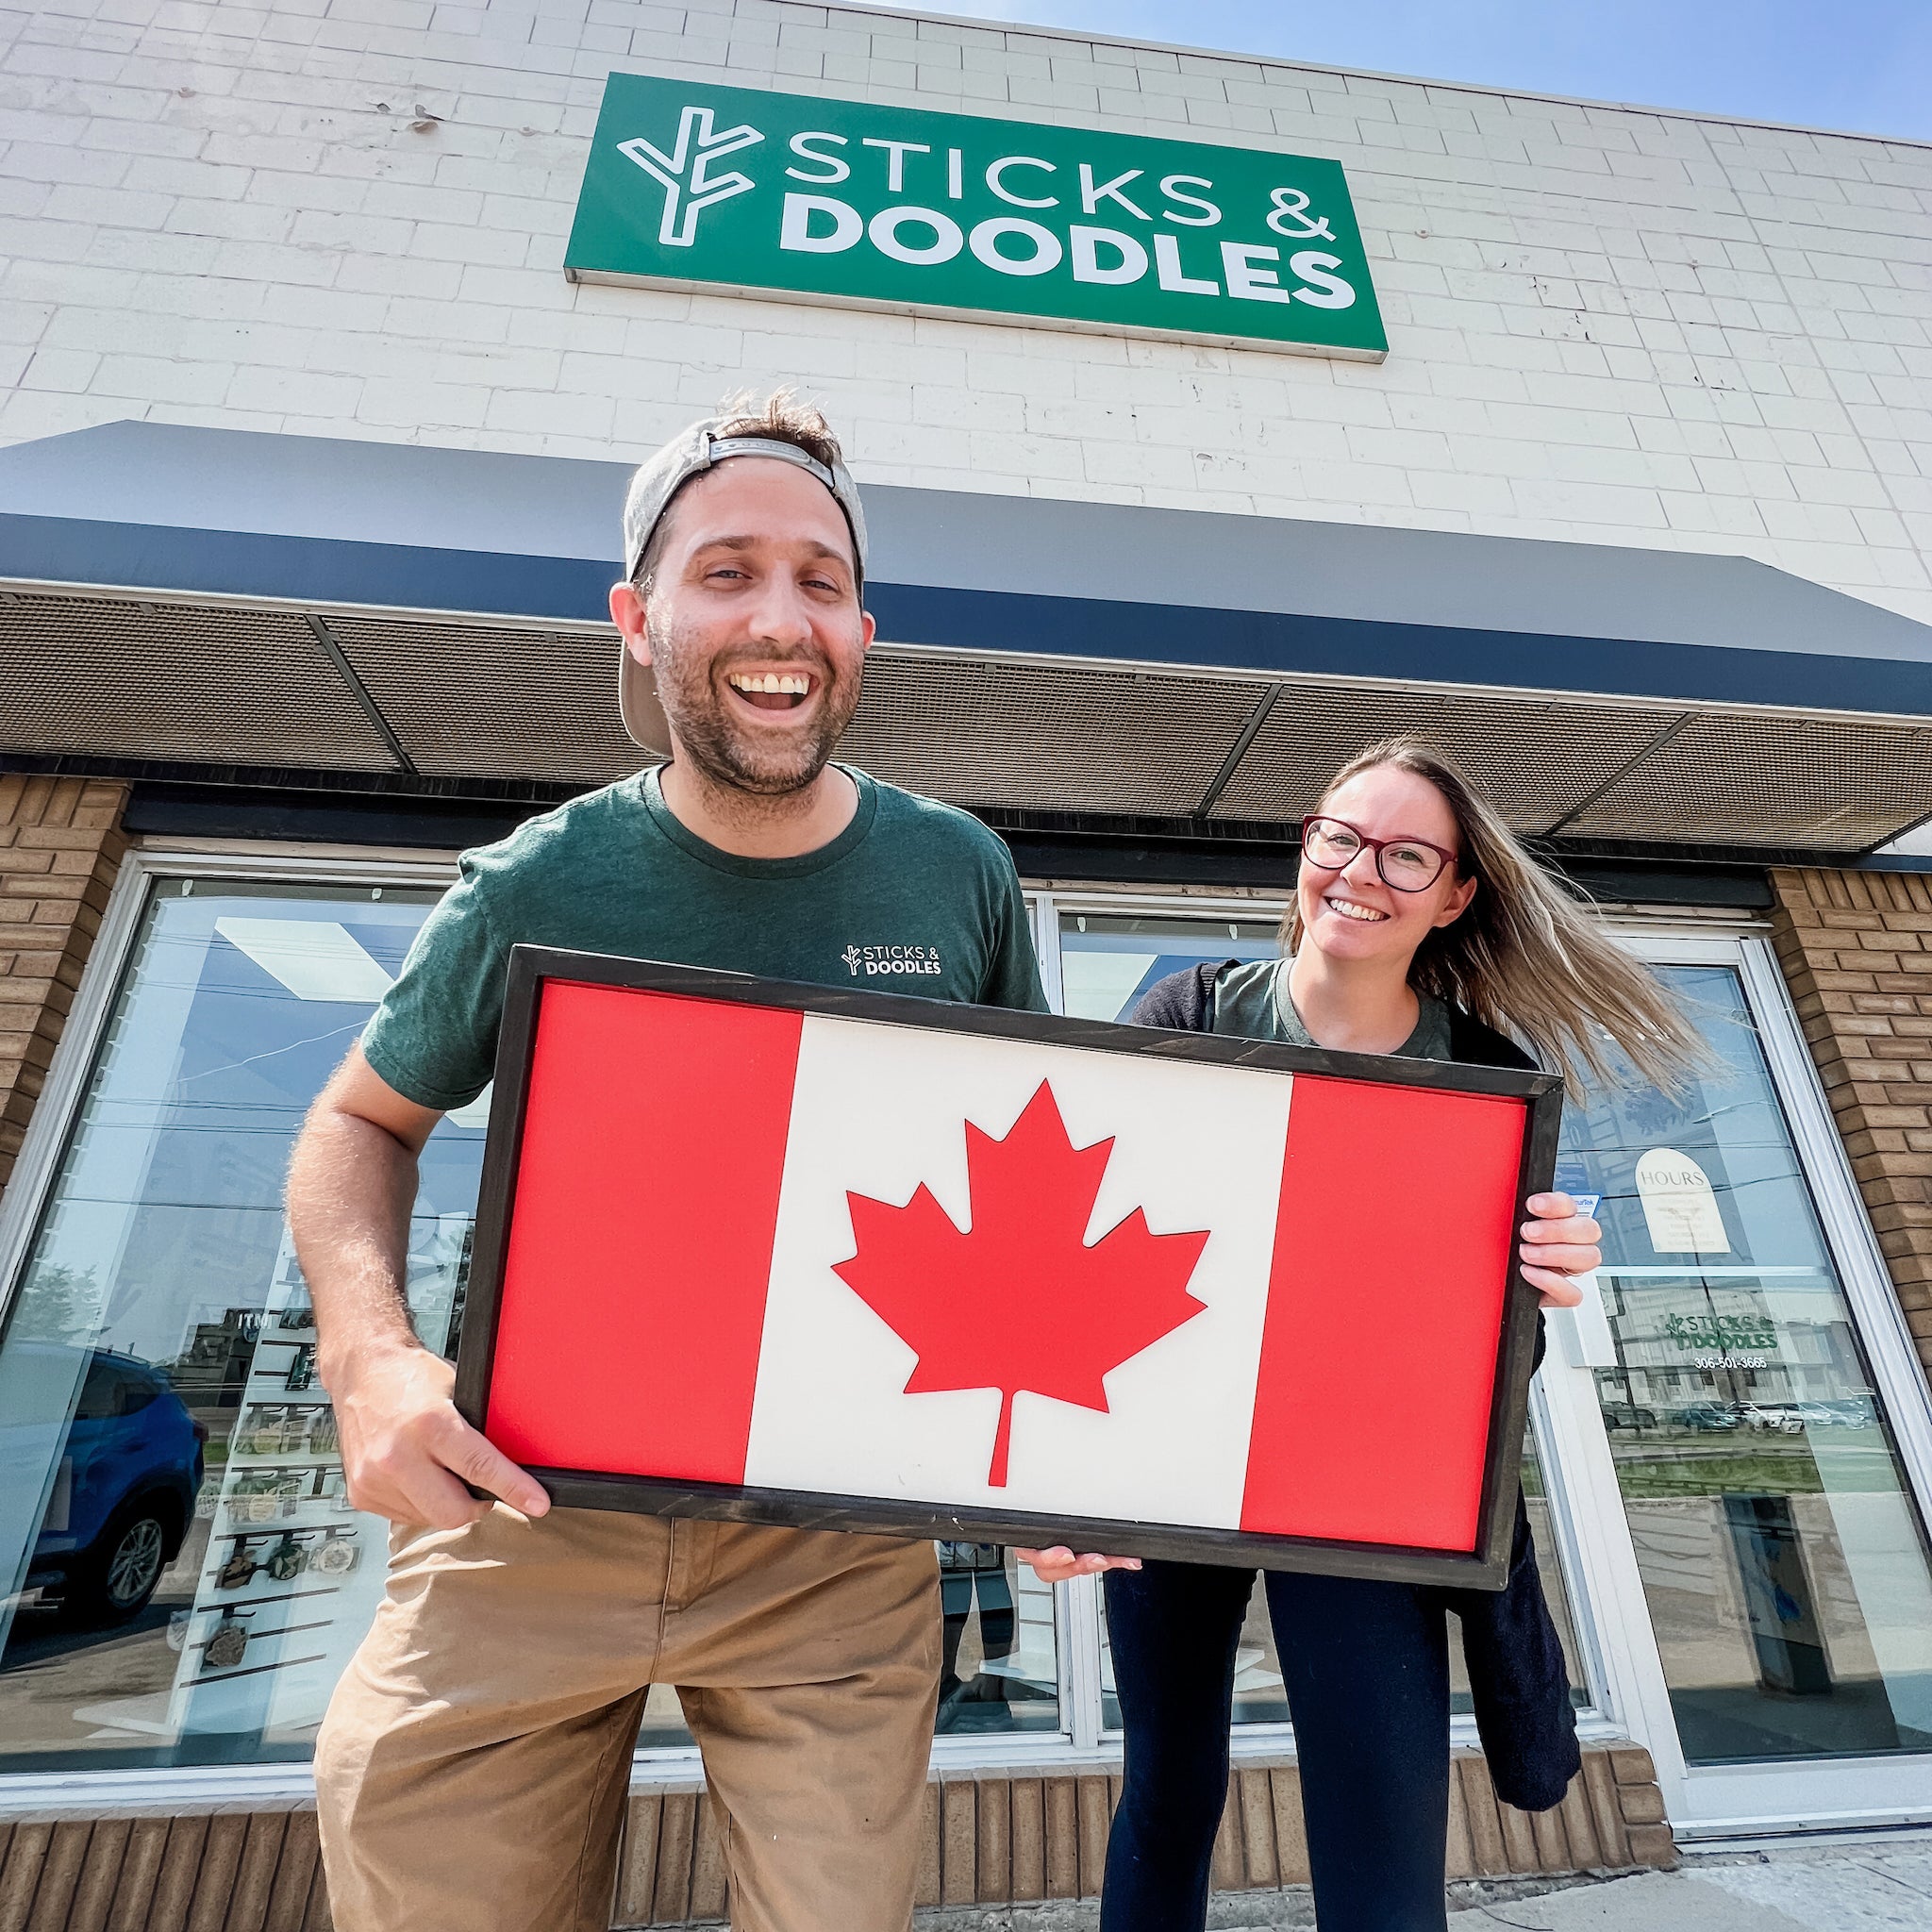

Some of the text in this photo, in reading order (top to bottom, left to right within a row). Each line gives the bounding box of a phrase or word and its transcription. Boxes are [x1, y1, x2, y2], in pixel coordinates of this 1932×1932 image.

[785, 132, 1336, 242] STICKS &
[780, 192, 1356, 309] DOODLES
[862, 946, 940, 960] STICKS &
[865, 960, 941, 975] DOODLES
[1641, 1171, 1705, 1186] HOURS
[1686, 1315, 1756, 1332] STICKS
[1690, 1333, 1777, 1350] DOODLES
[1694, 1357, 1767, 1369] 306-501-3665
